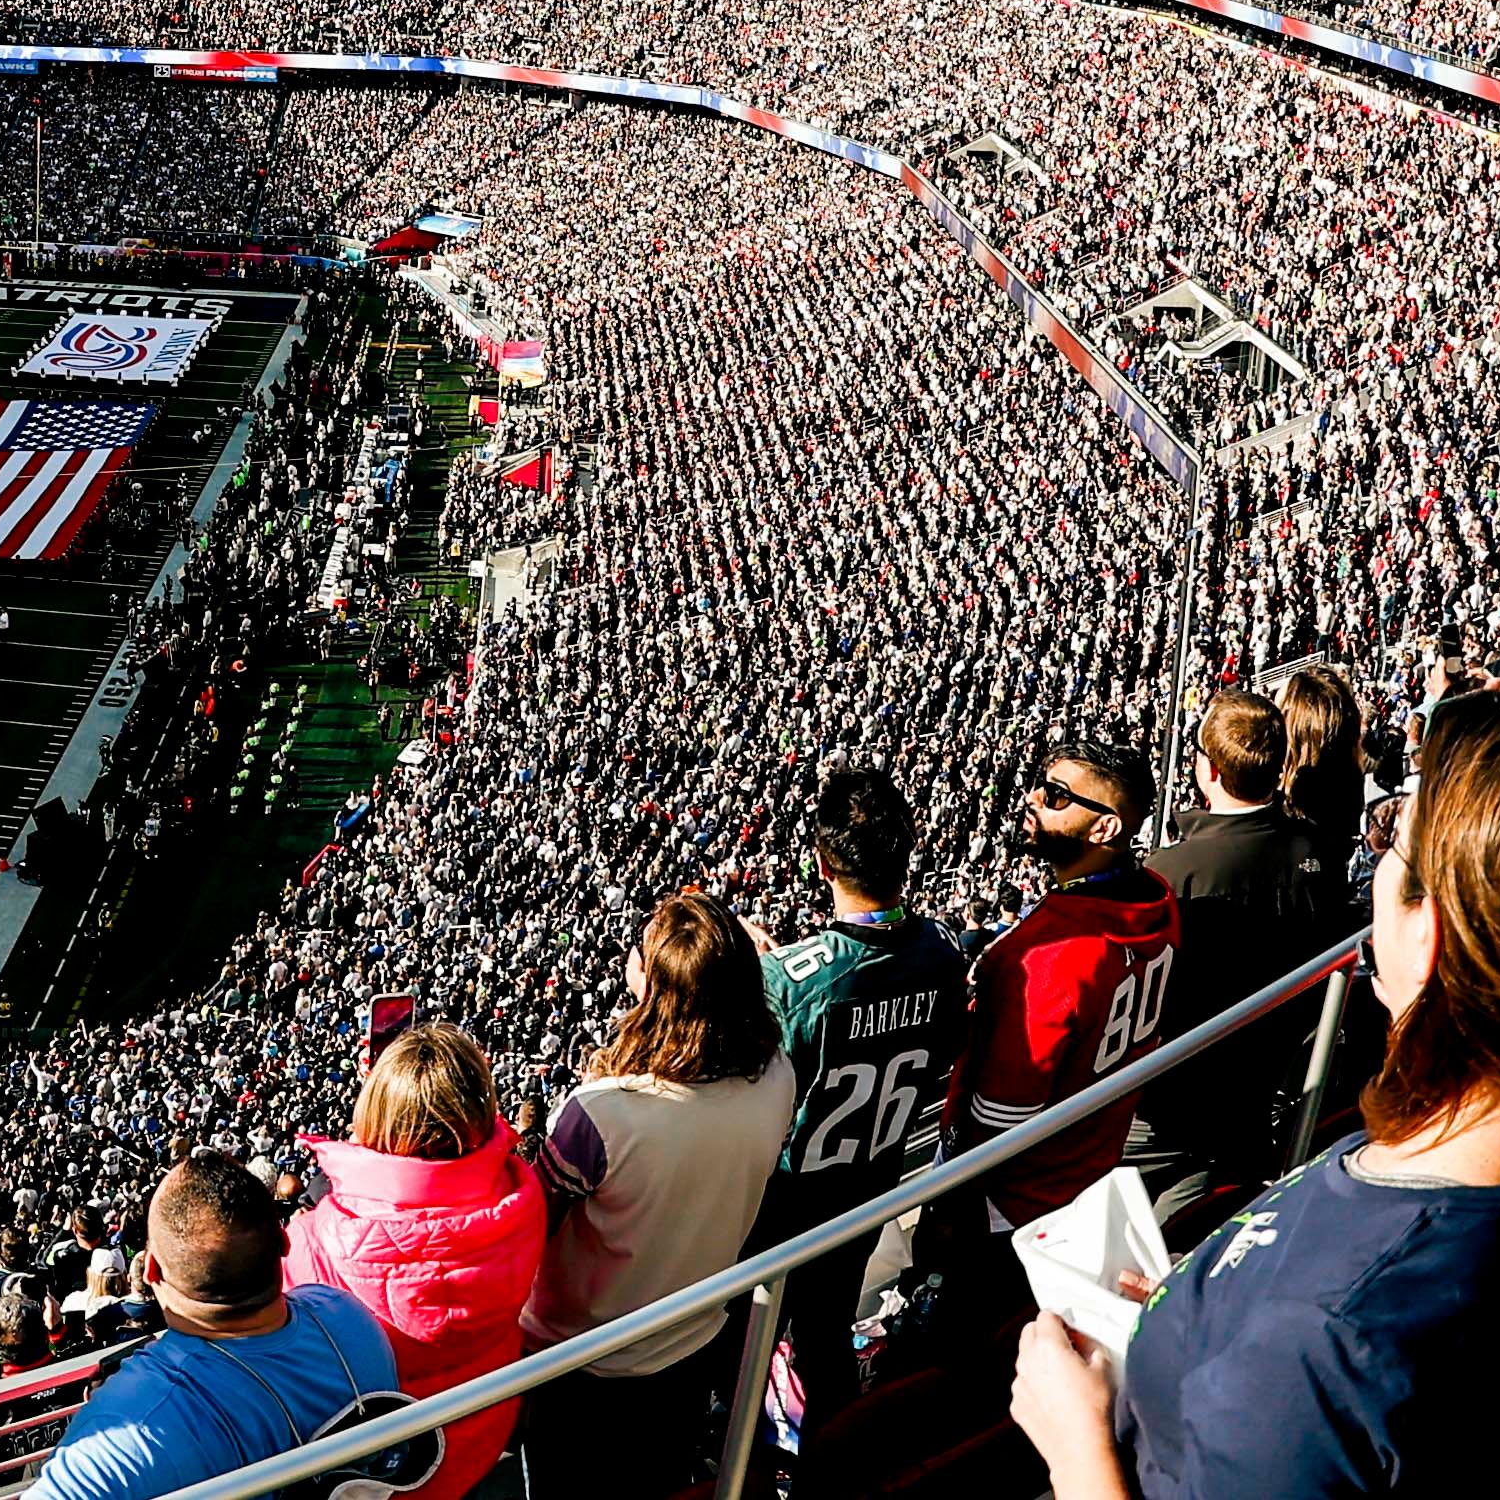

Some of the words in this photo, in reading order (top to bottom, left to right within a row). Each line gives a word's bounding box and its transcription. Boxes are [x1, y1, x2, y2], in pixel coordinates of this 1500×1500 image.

[205, 70, 277, 80] PATRIOTS
[848, 989, 938, 1040] BARKLEY
[1093, 943, 1174, 1074] 80
[800, 1048, 929, 1173] 26
